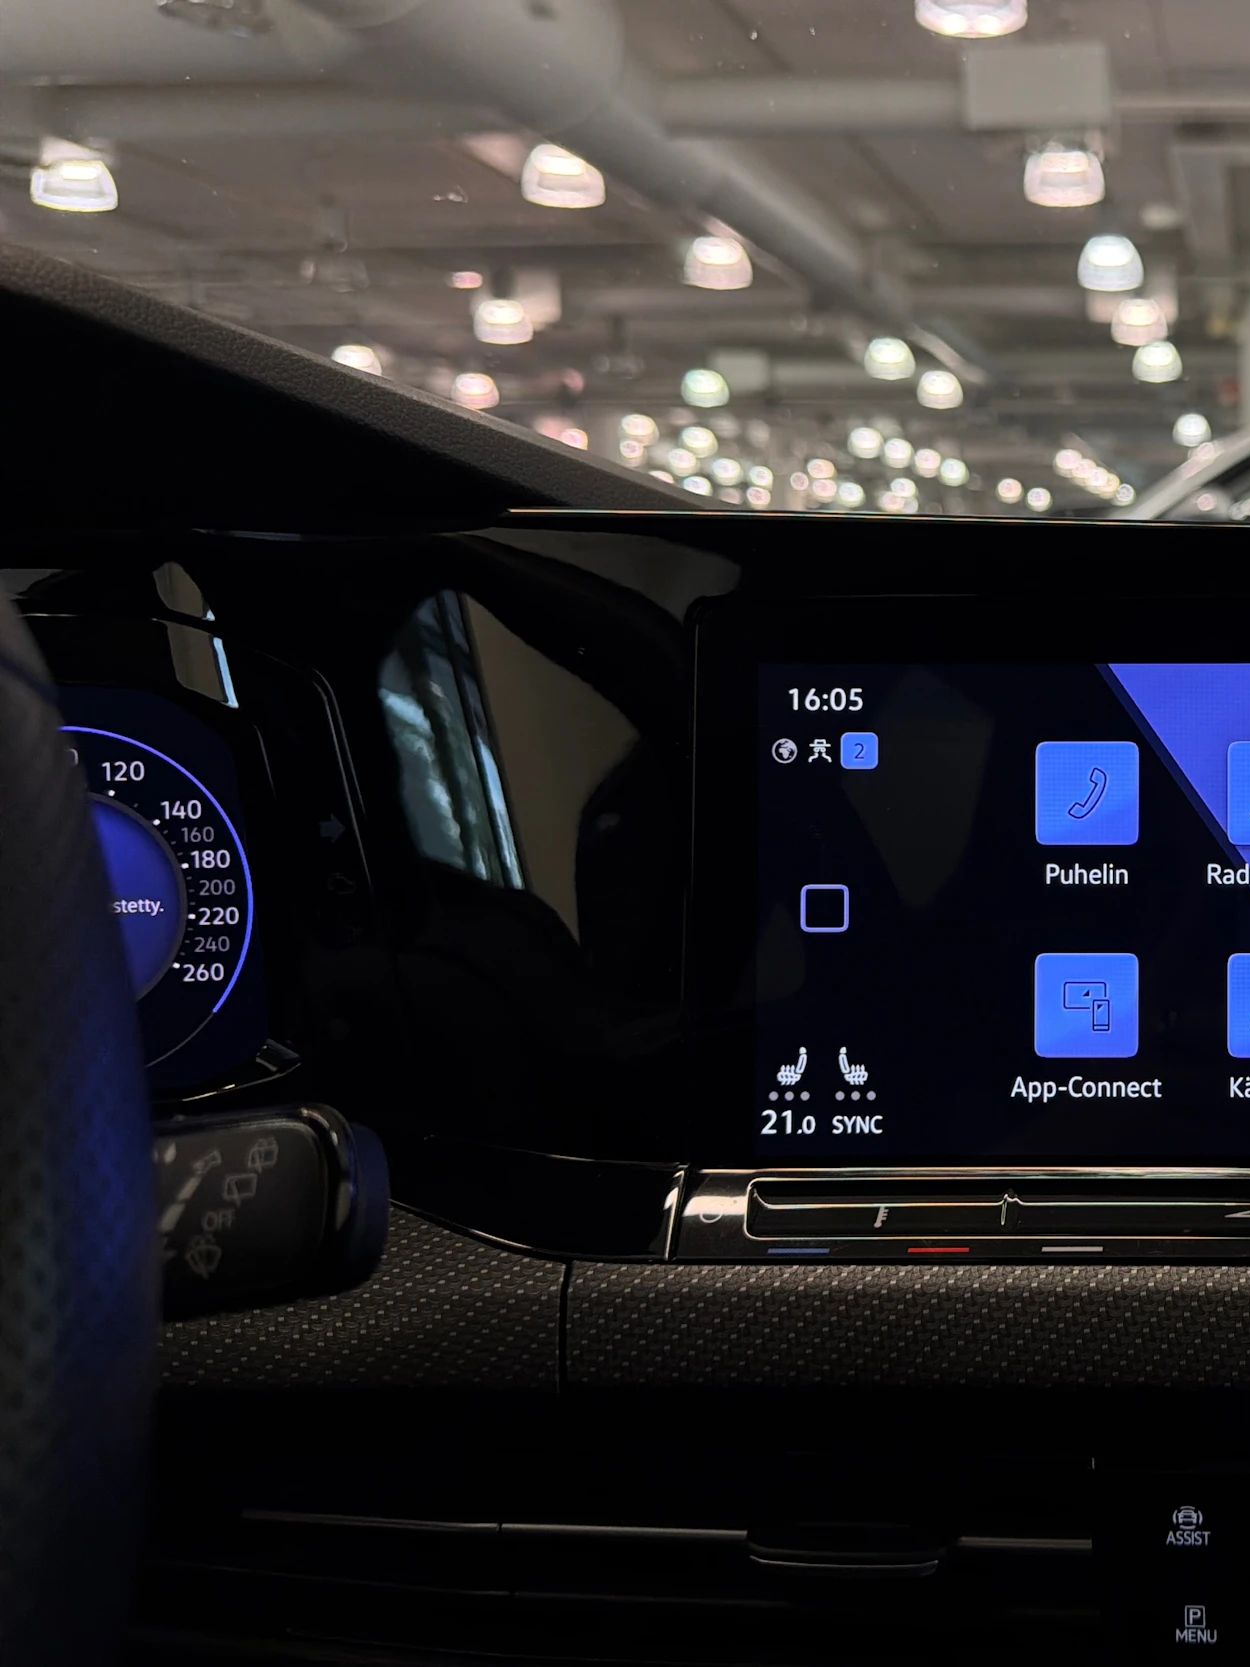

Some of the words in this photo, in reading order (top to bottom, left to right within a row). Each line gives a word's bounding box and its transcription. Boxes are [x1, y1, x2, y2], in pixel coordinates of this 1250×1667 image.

[787, 687, 865, 712] 16:05
[854, 742, 865, 760] 2
[101, 760, 146, 783] 120
[160, 799, 203, 821] 140
[180, 826, 216, 844] 160
[190, 849, 232, 871] 180
[1045, 862, 1130, 886] Puhelin
[199, 878, 237, 897] 200
[109, 899, 165, 917] stetty.
[198, 906, 241, 927] 220
[193, 935, 231, 954] 240
[182, 962, 226, 983] 260
[1010, 1074, 1163, 1104] App-Connect
[760, 1109, 817, 1136] 21.0
[831, 1115, 884, 1136] SYNC
[1165, 1530, 1212, 1547] ASSIST
[1175, 1628, 1218, 1644] MENU
